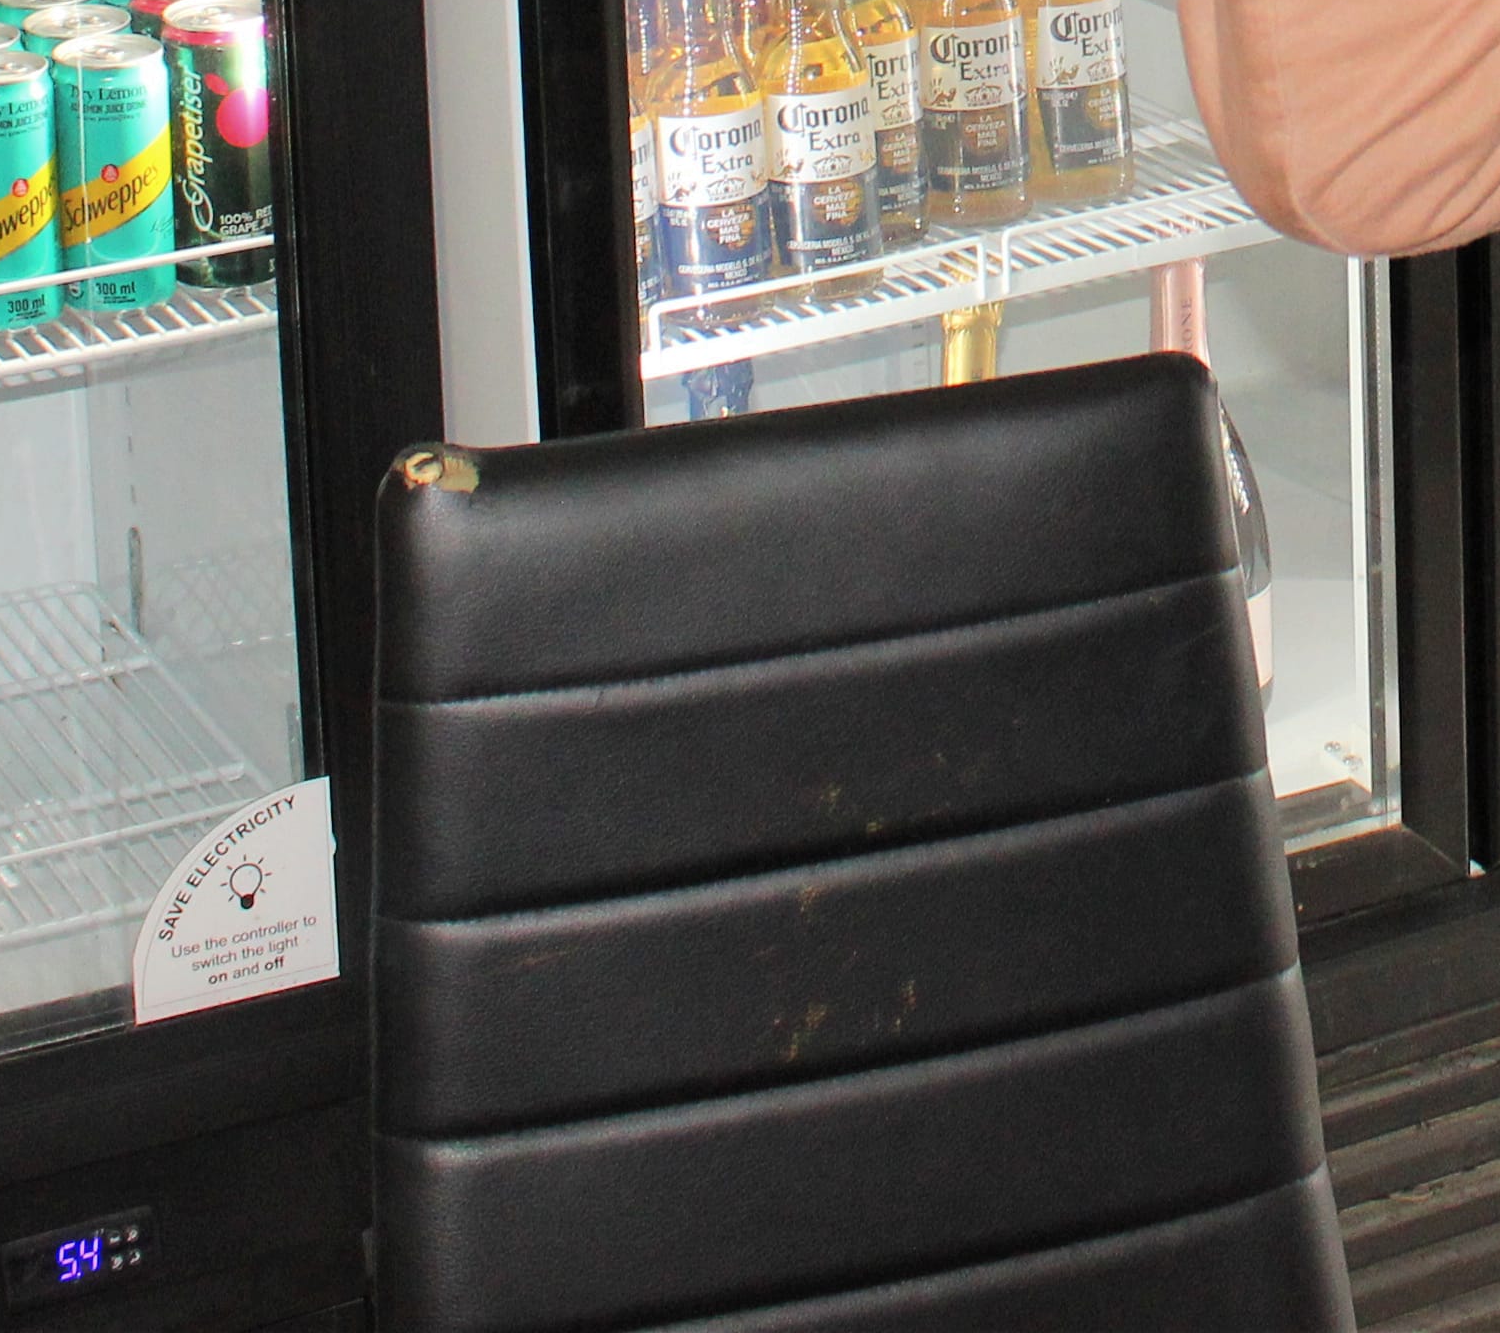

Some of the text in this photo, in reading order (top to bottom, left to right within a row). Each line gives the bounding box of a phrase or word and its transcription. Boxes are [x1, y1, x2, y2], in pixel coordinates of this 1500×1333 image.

[959, 61, 1010, 82] Extra
[776, 97, 870, 138] Corona
[178, 64, 214, 232] Grapetiser
[669, 118, 762, 162] Corona
[809, 130, 861, 152] Extra
[702, 154, 754, 176] Extra
[64, 161, 159, 231] Schweppes
[220, 211, 253, 225] 100%
[7, 293, 46, 312] 300 ml
[120, 280, 136, 295] ml
[158, 794, 296, 942] SAVE ELECTRICITY
[171, 915, 317, 959] Use the controller to
[191, 935, 299, 973] switch the light
[208, 955, 286, 985] on and off
